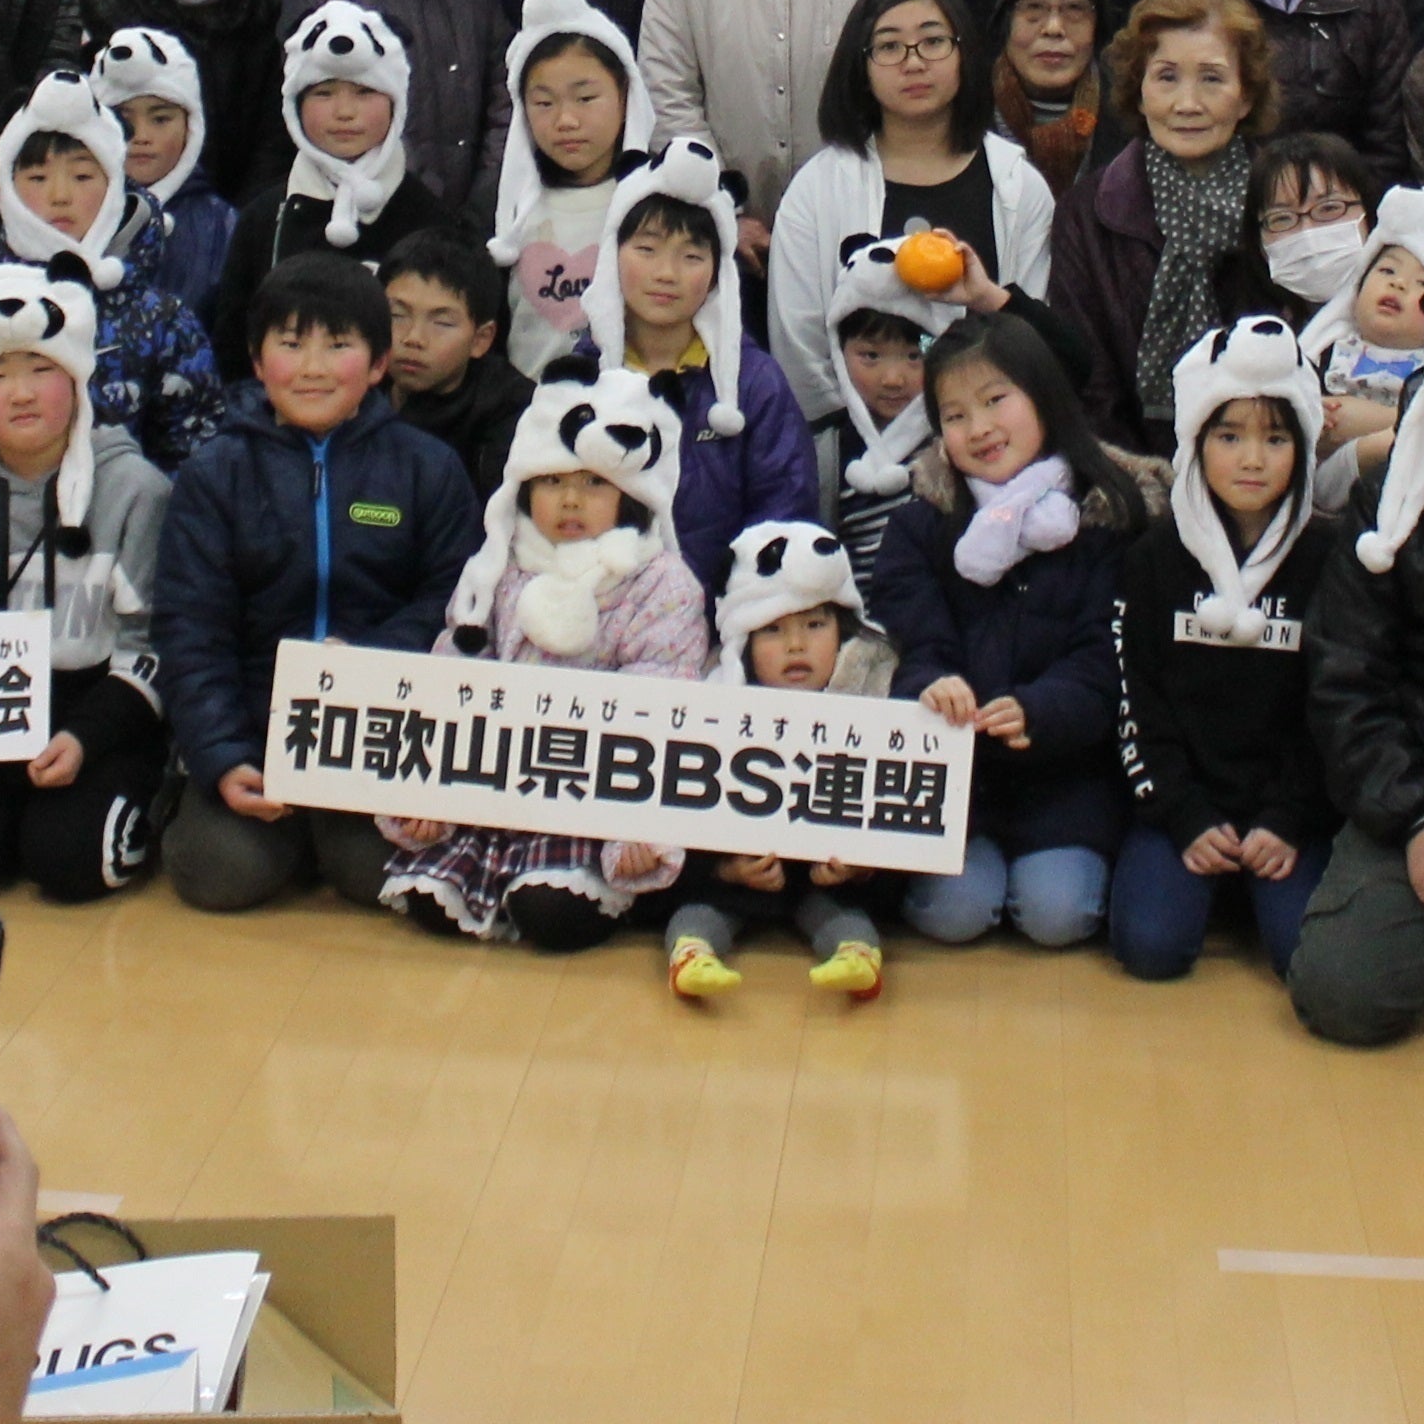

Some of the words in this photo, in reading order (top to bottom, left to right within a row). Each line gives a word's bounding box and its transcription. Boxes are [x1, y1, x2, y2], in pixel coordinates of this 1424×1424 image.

[285, 697, 948, 836] 和歌山県BBS連盟
